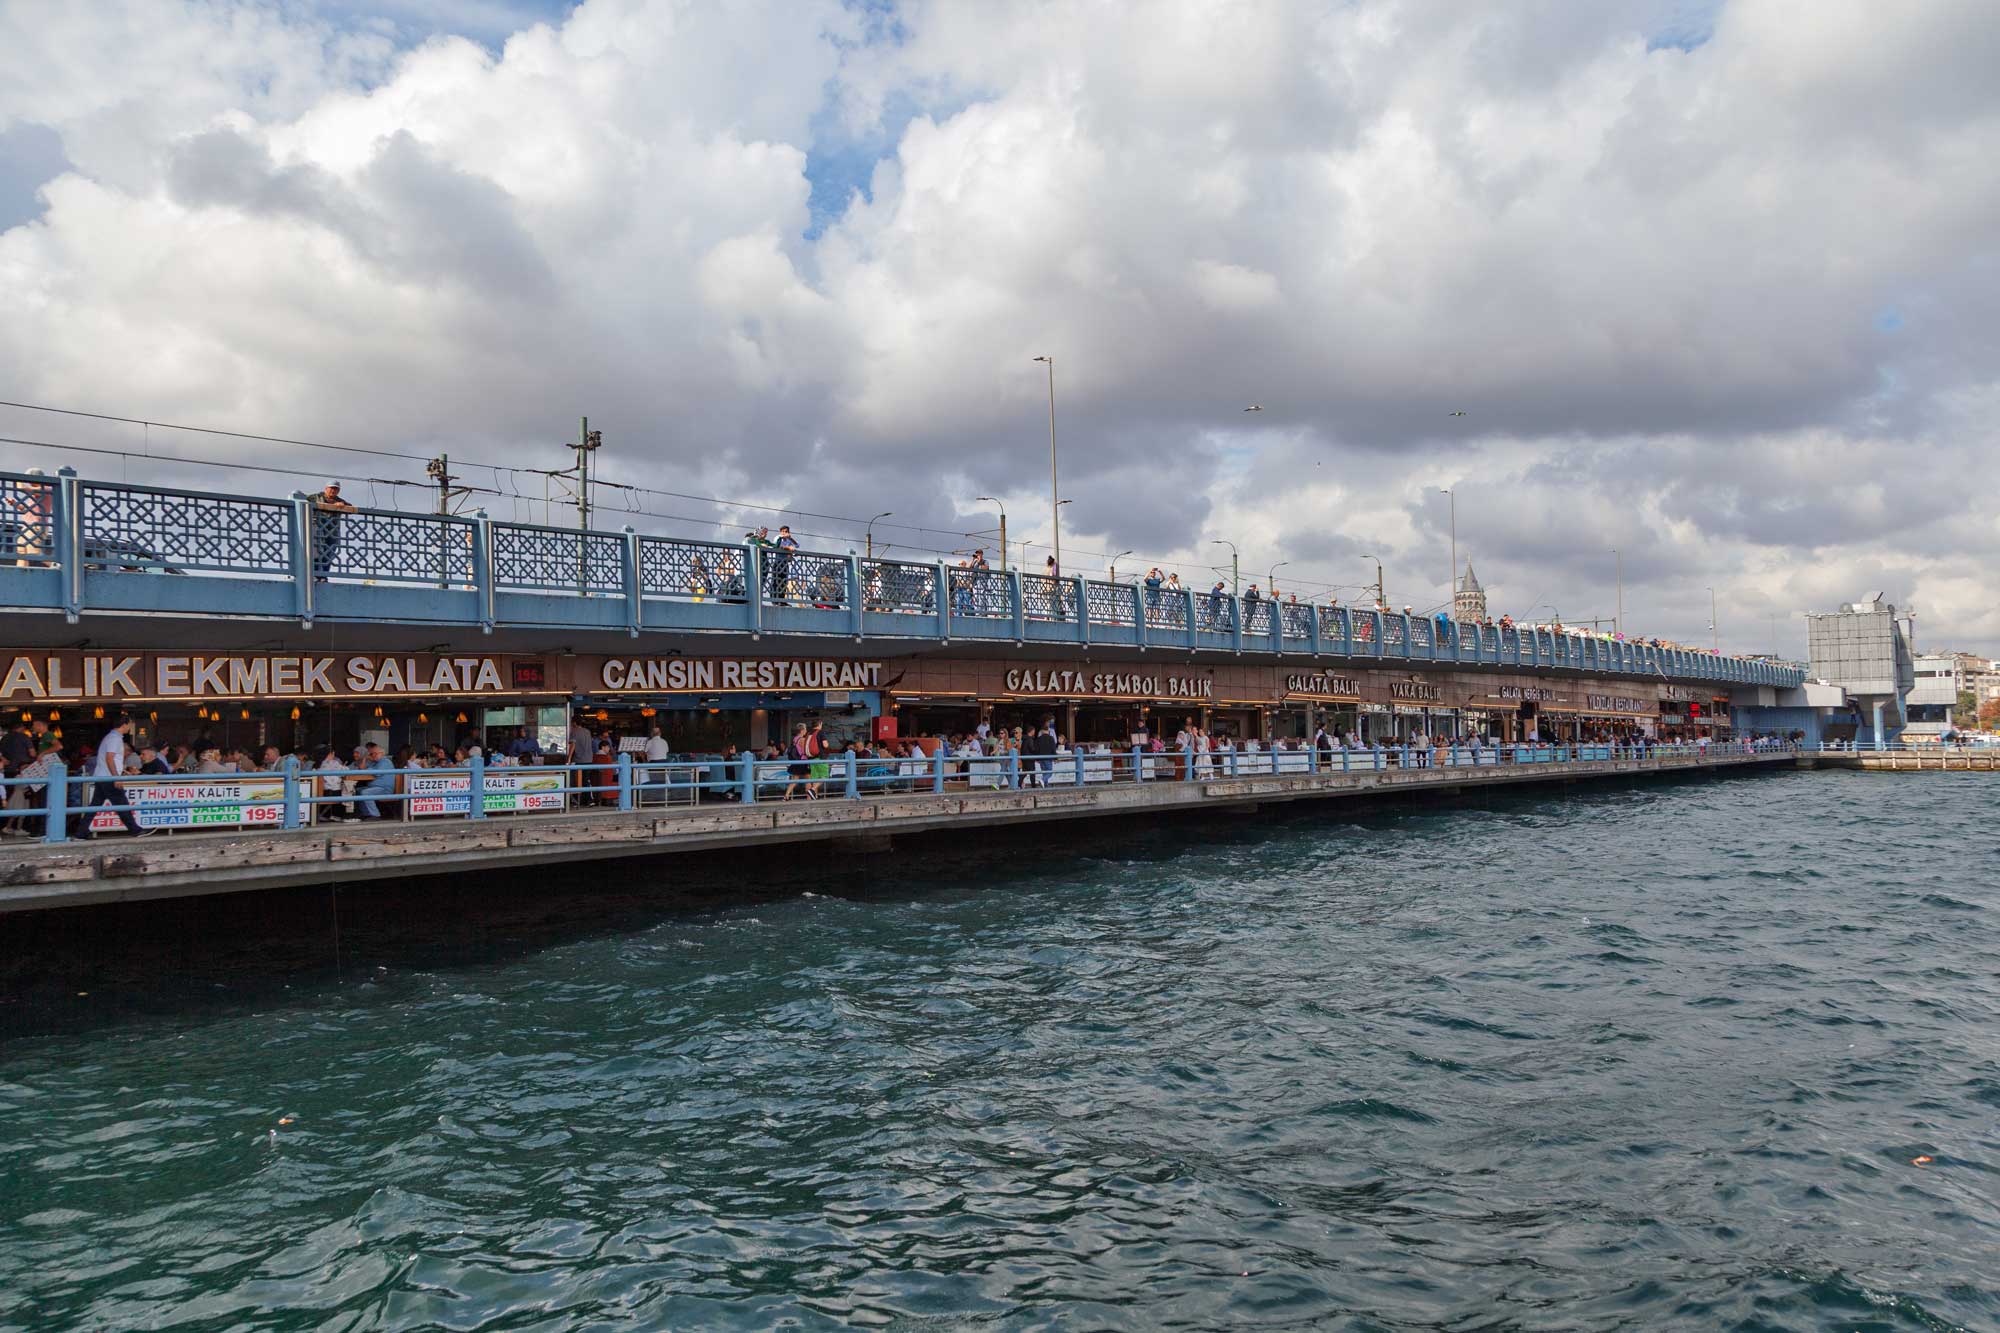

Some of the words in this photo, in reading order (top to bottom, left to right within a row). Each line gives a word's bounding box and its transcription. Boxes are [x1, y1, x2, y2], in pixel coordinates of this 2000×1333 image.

[156, 656, 337, 695] EKMEK
[346, 656, 504, 692] SALATA
[603, 659, 714, 689] CANSIN
[722, 661, 882, 689] RESTAURANT
[1006, 669, 1086, 692] GALATA
[1093, 673, 1162, 696] SEMBOL
[1168, 677, 1212, 697] BALIK
[1288, 675, 1329, 693] GALATA
[1333, 679, 1360, 695] BALIK
[1391, 683, 1416, 698] YAKA
[1418, 686, 1442, 701] BALIK
[1502, 686, 1521, 699] GALATA
[414, 780, 449, 790] LEZZET
[447, 803, 471, 811] BREA
[522, 797, 541, 807] 195
[142, 816, 187, 826] BREAD
[196, 814, 238, 824] SALAD
[246, 808, 277, 821] 195
